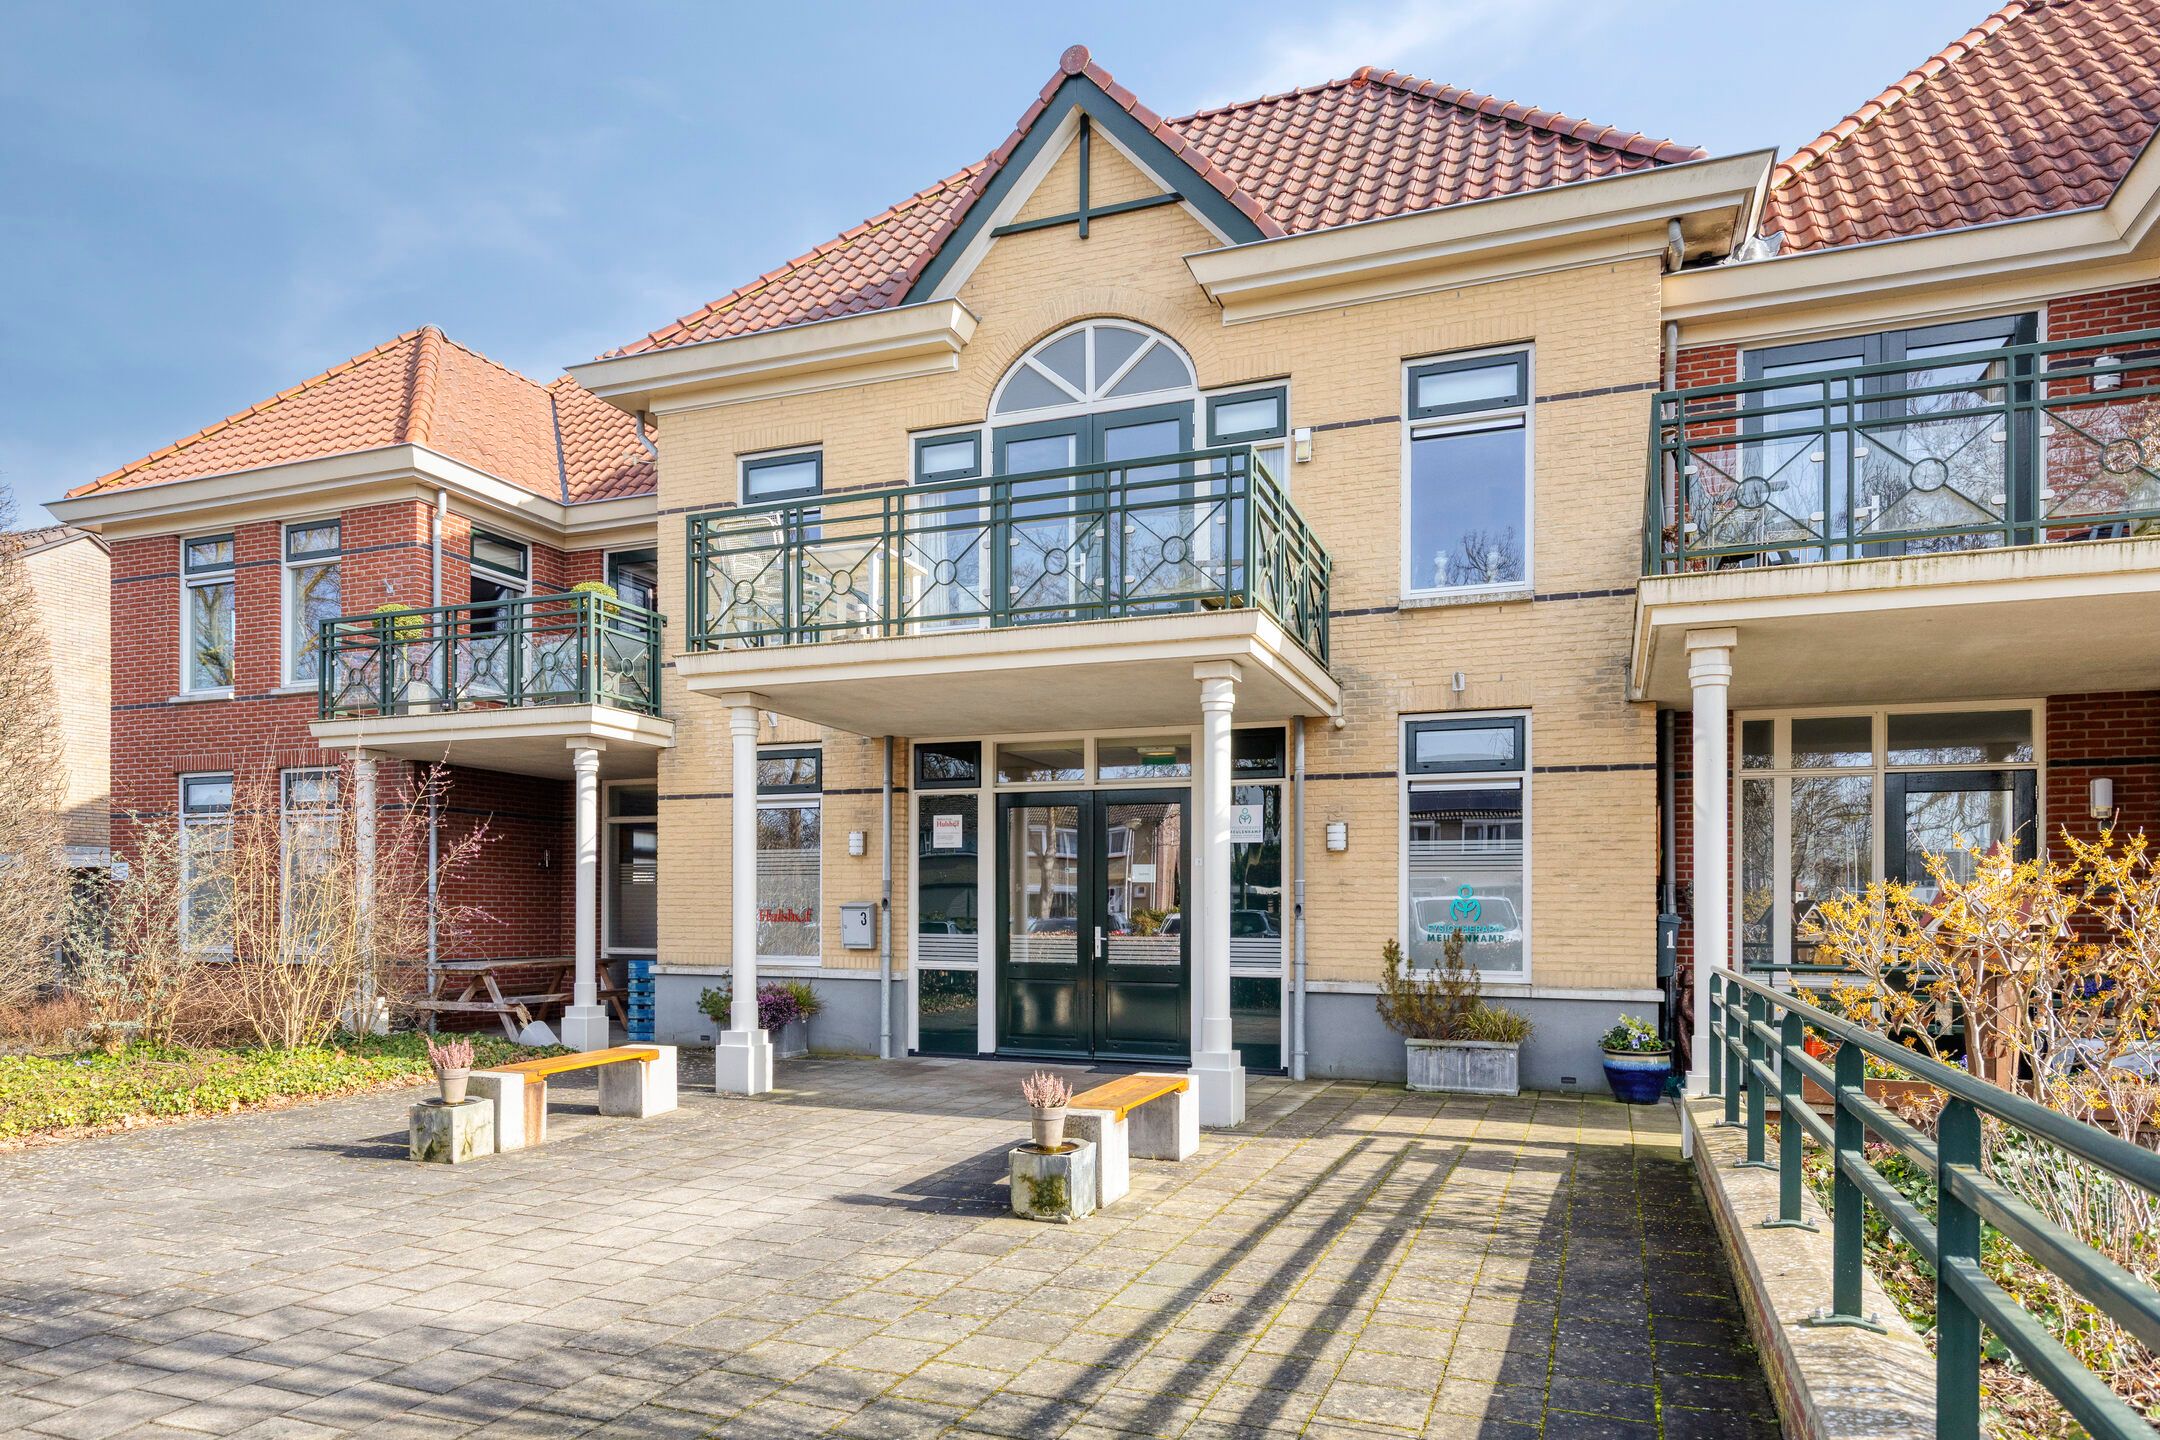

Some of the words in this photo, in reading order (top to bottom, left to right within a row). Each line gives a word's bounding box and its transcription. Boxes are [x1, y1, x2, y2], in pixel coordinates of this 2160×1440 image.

[860, 911, 867, 926] 3
[1426, 934, 1505, 943] MEUNKAMP
[1666, 929, 1676, 949] 1
